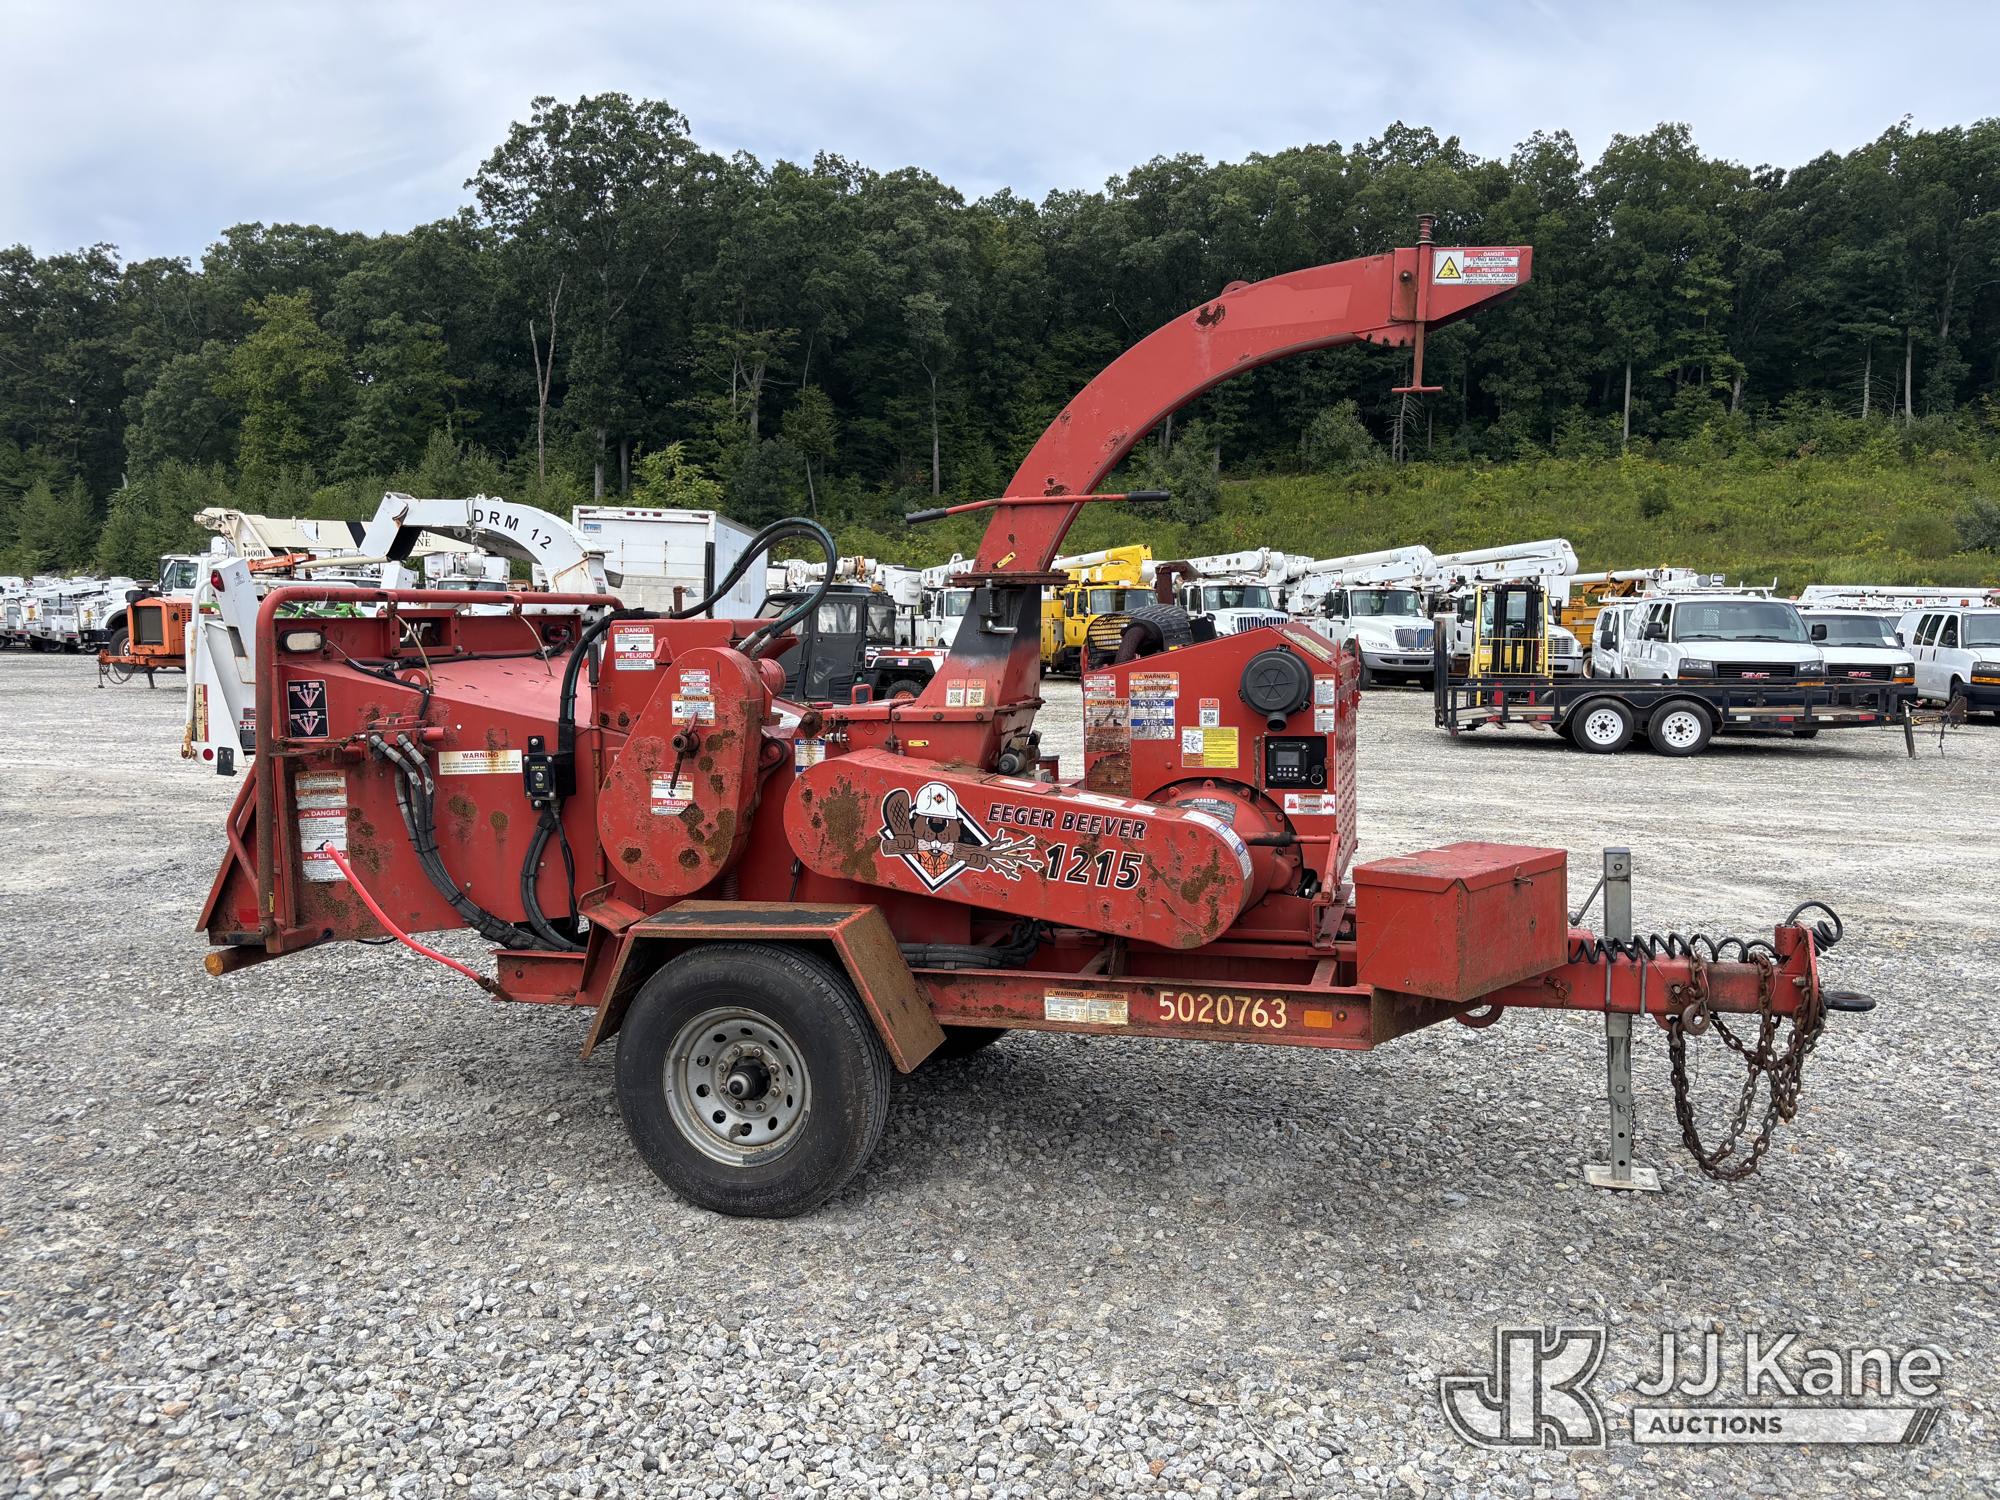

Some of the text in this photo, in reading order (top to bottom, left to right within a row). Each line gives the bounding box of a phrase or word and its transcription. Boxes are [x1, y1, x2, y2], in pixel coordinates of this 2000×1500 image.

[473, 509, 552, 550] DRM 12
[310, 809, 341, 817] DANGER
[662, 799, 689, 807] PELIGRO
[988, 803, 1147, 840] EEGER BEEVER
[313, 851, 344, 860] PELIO
[1046, 843, 1144, 890] 1215
[1054, 990, 1084, 998] WARNING
[1159, 991, 1287, 1029] 5020763
